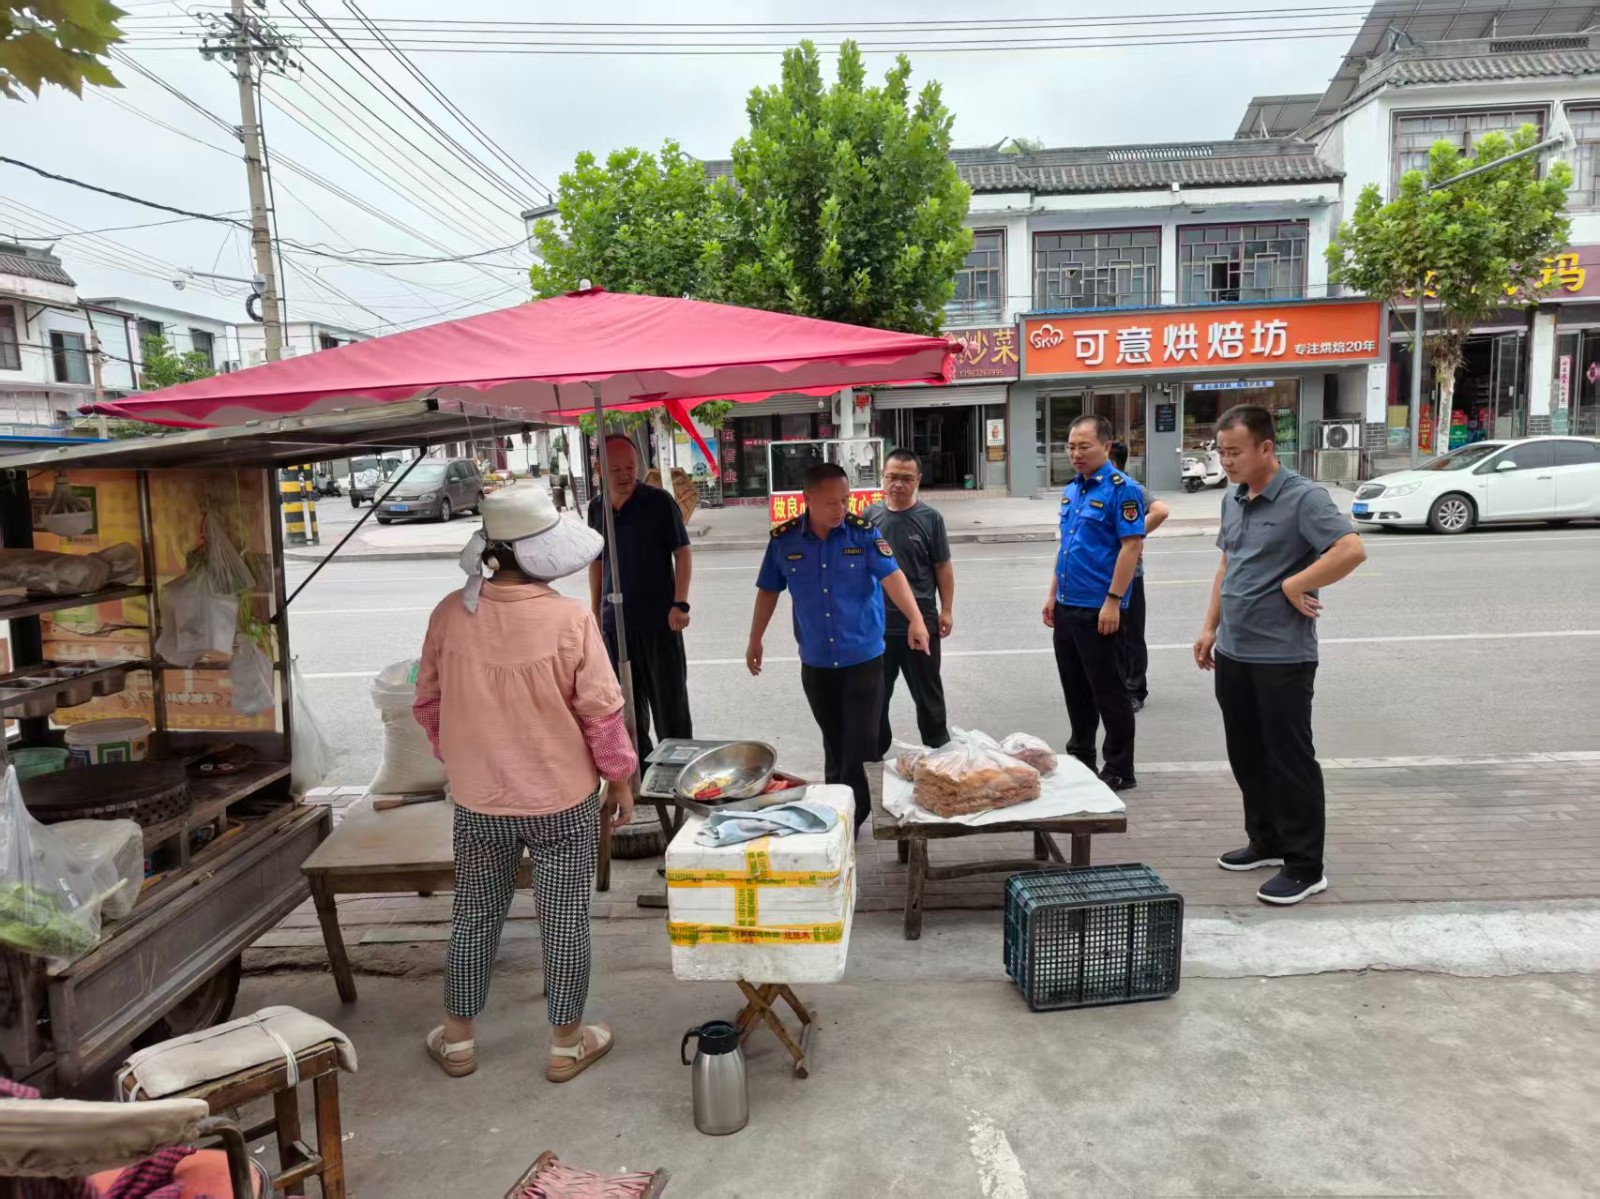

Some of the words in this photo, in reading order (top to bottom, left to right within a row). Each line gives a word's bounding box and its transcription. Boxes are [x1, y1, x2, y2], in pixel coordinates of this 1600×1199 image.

[1073, 319, 1289, 365] 可意烘焙坊
[1294, 340, 1376, 354] 专注烘焙20年
